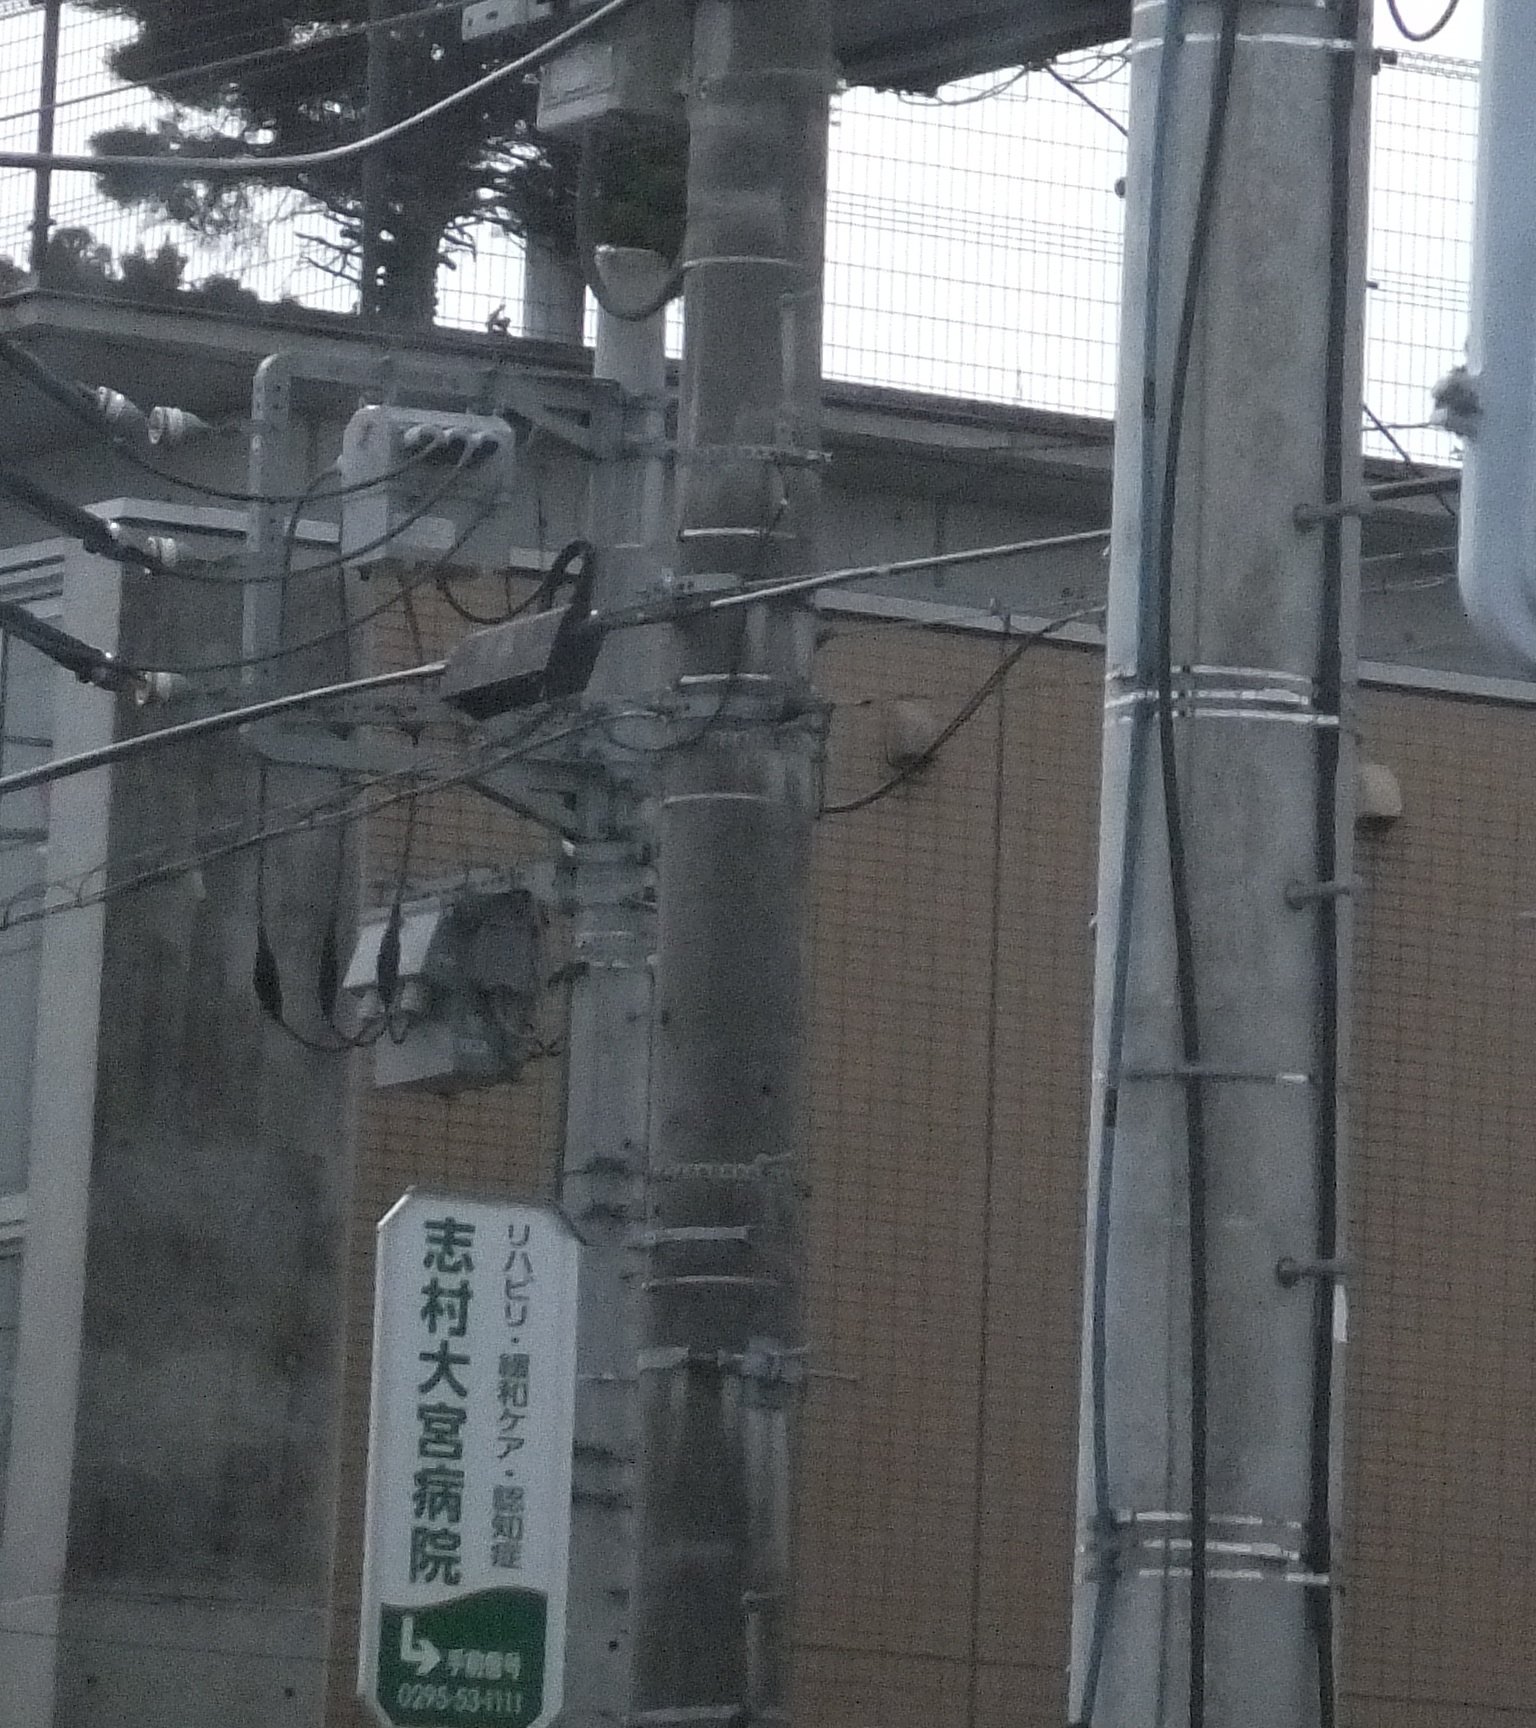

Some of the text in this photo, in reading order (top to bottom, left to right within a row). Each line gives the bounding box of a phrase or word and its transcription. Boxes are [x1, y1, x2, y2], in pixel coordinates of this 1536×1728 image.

[408, 1216, 476, 1587] 志村大宮病院
